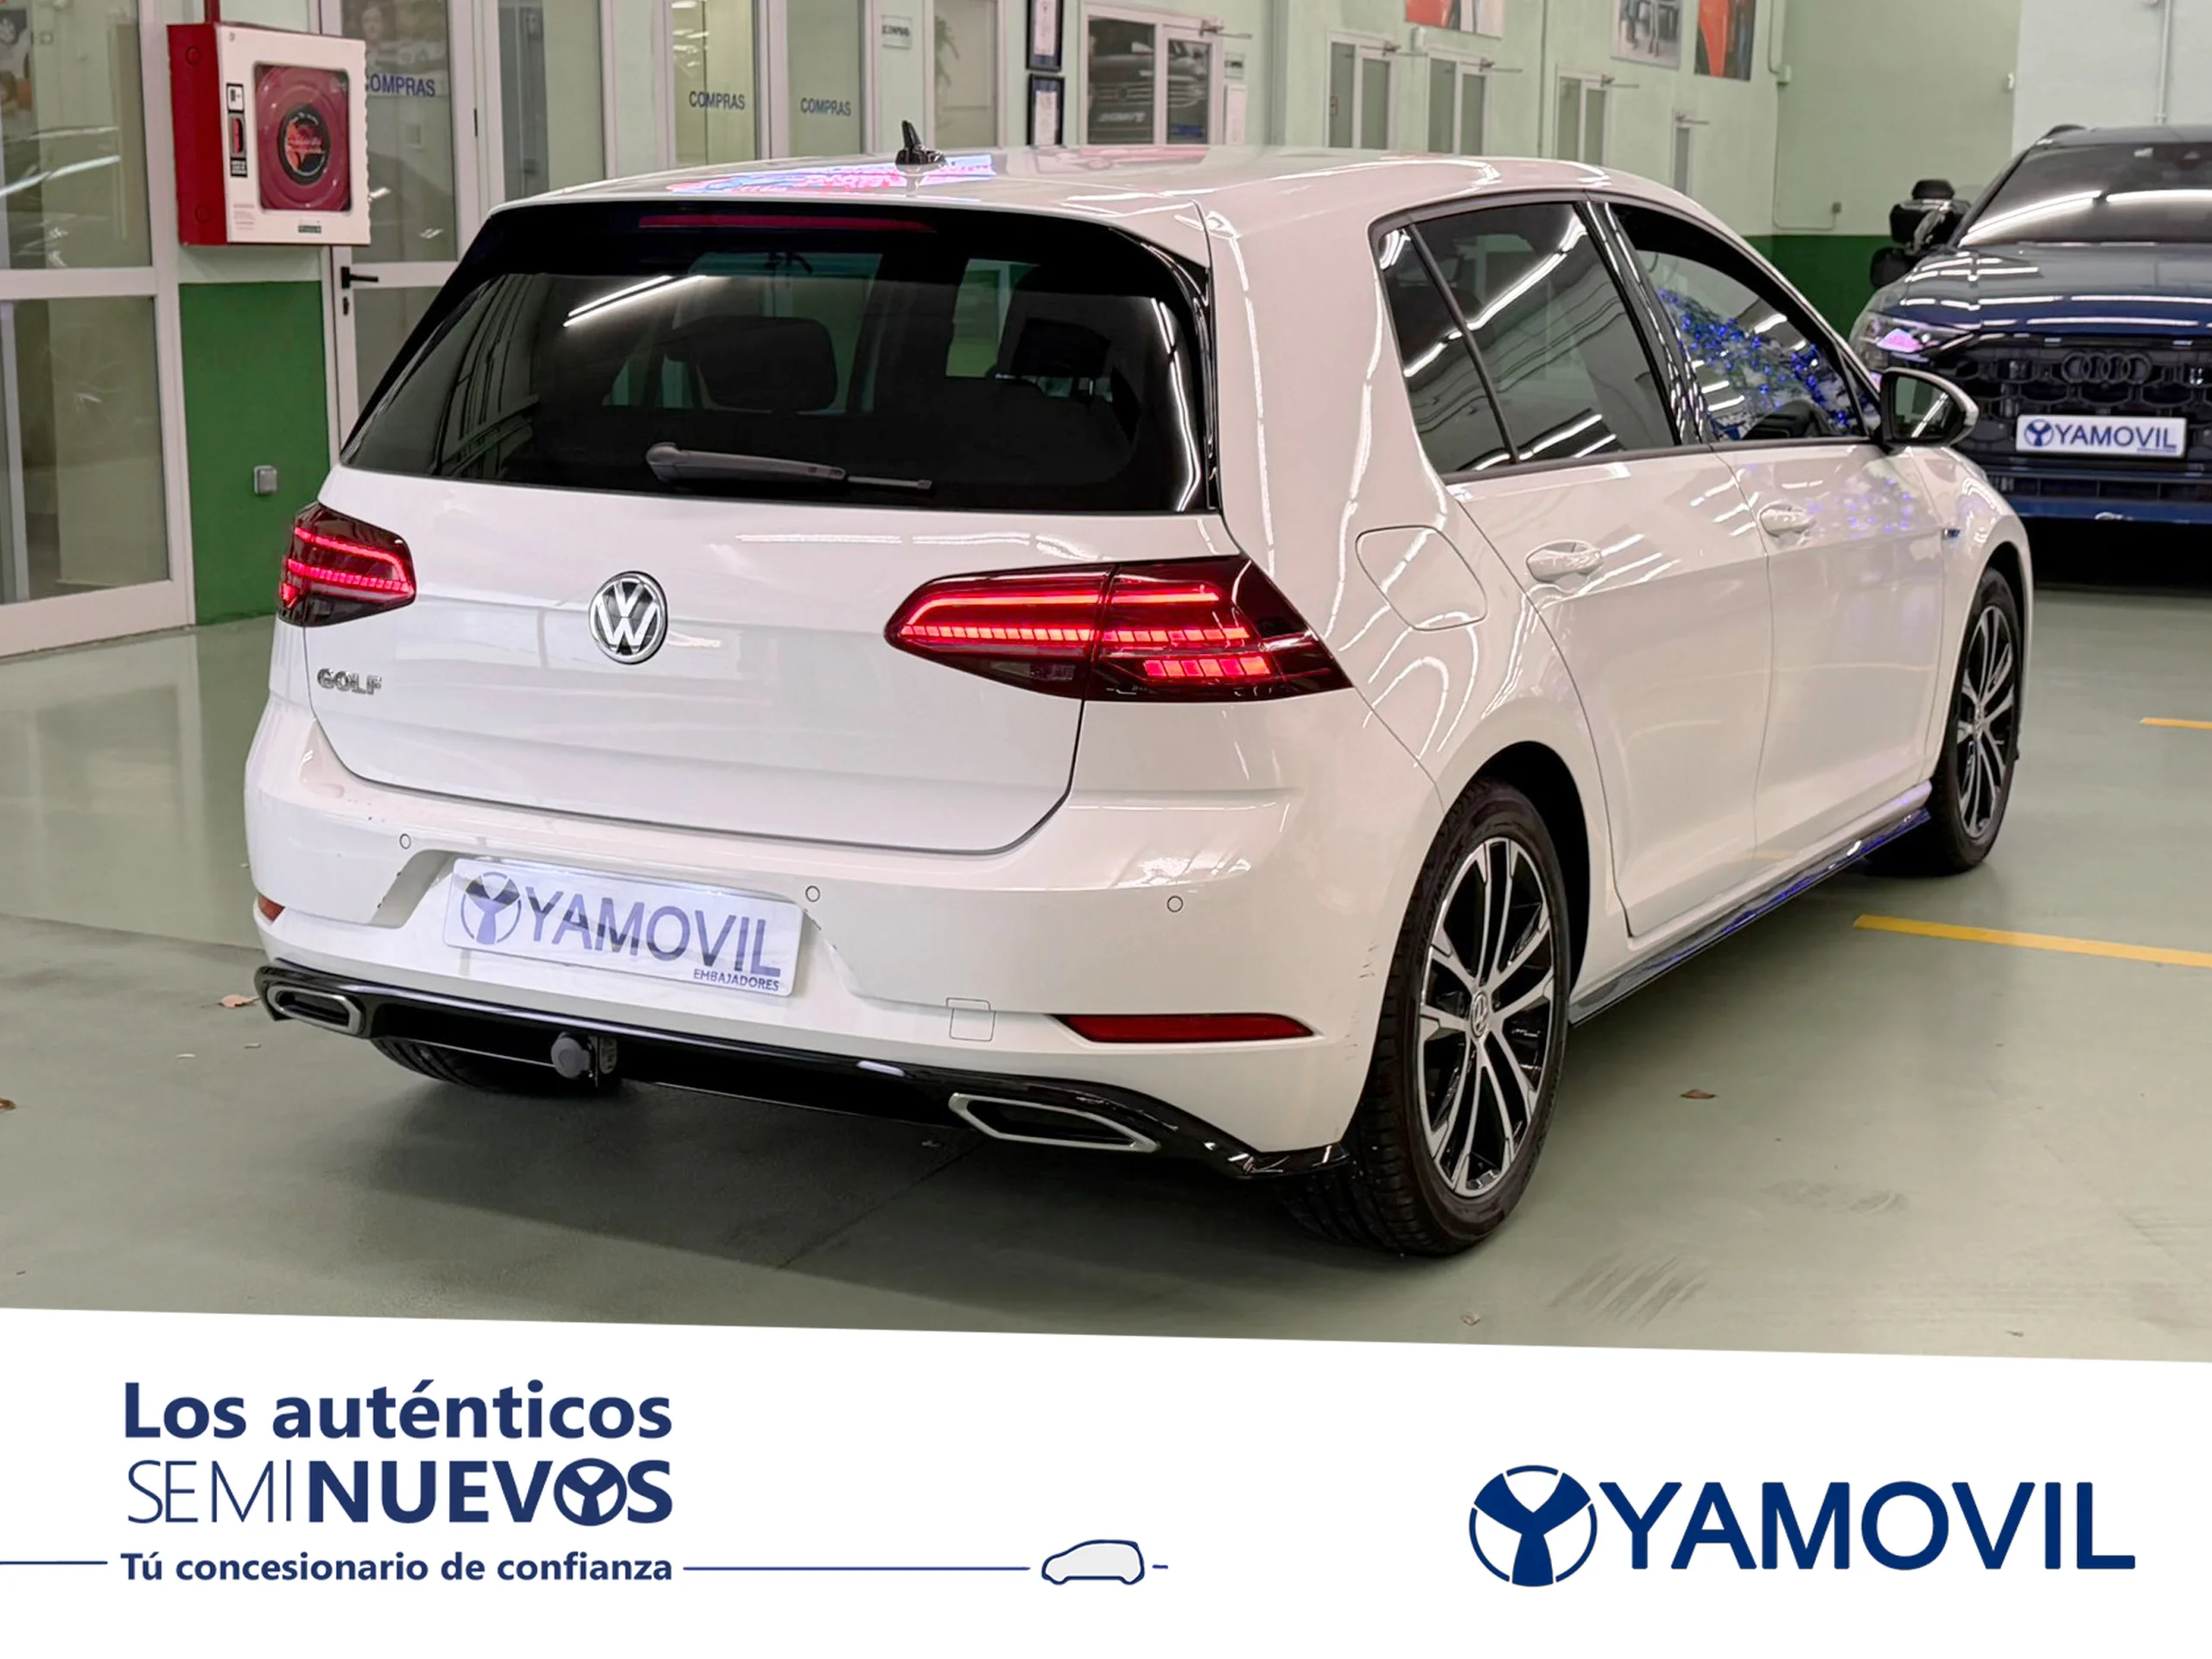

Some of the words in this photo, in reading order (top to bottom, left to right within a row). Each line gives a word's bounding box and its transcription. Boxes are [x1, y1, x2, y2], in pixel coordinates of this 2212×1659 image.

[365, 73, 435, 97] OMPRAS
[689, 91, 746, 110] COMPRAS
[800, 97, 852, 117] COMPRAS
[2055, 423, 2177, 448] YAMOVIL
[316, 668, 382, 695] GOLF
[524, 886, 781, 977] YAMOVIL
[693, 968, 779, 991] EMBAJADORES
